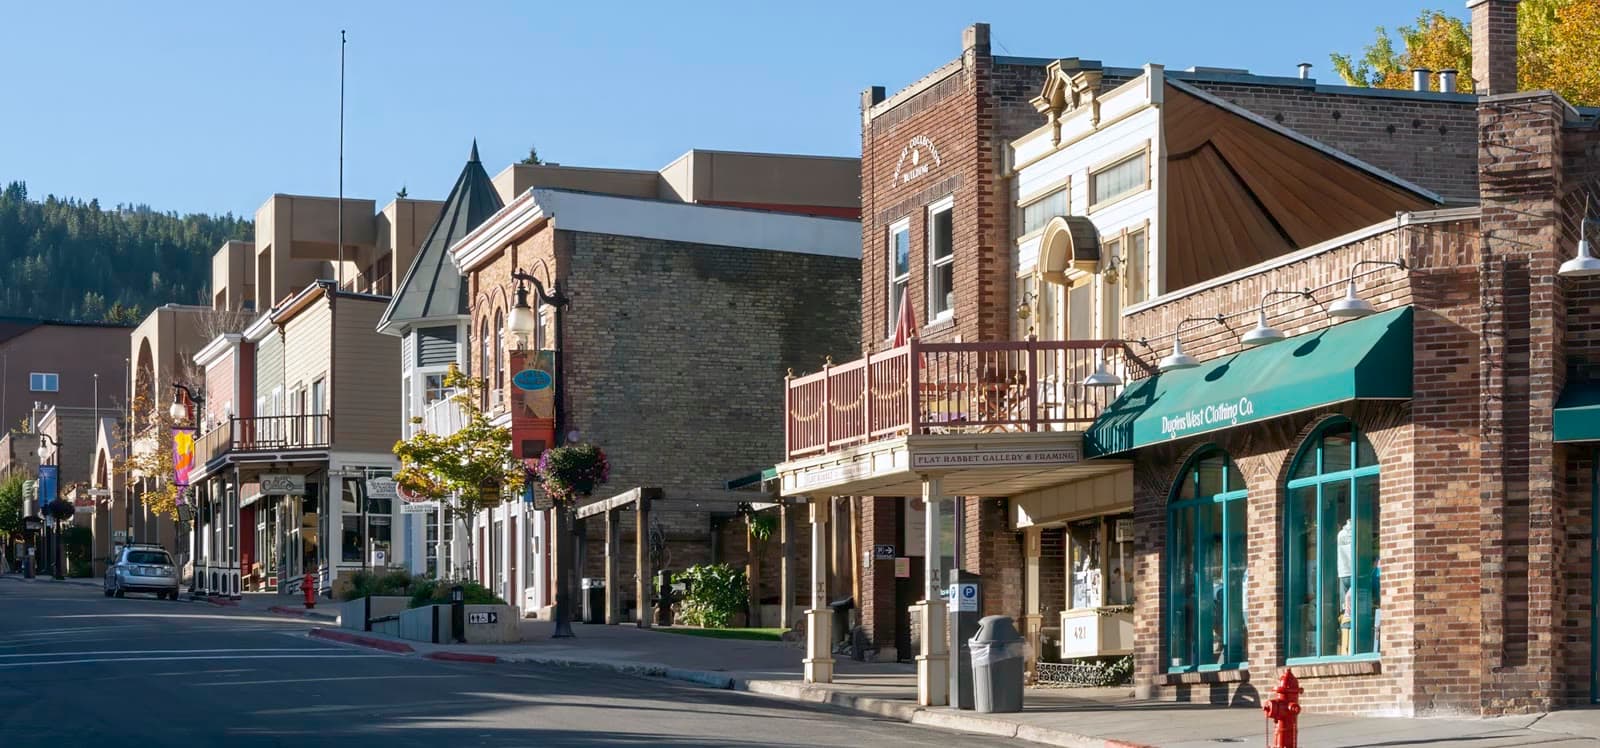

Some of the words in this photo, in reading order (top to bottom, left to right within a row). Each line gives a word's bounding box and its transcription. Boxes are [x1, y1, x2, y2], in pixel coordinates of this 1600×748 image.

[903, 164, 929, 182] BUILDING
[1205, 403, 1238, 425] Clothing
[1239, 397, 1253, 416] Co.
[918, 455, 941, 464] FLAT
[943, 454, 979, 463] RABBET
[982, 453, 1023, 462] GALLERY
[1025, 453, 1033, 461] &
[1034, 451, 1075, 461] FRAMING
[1074, 626, 1087, 641] 421
